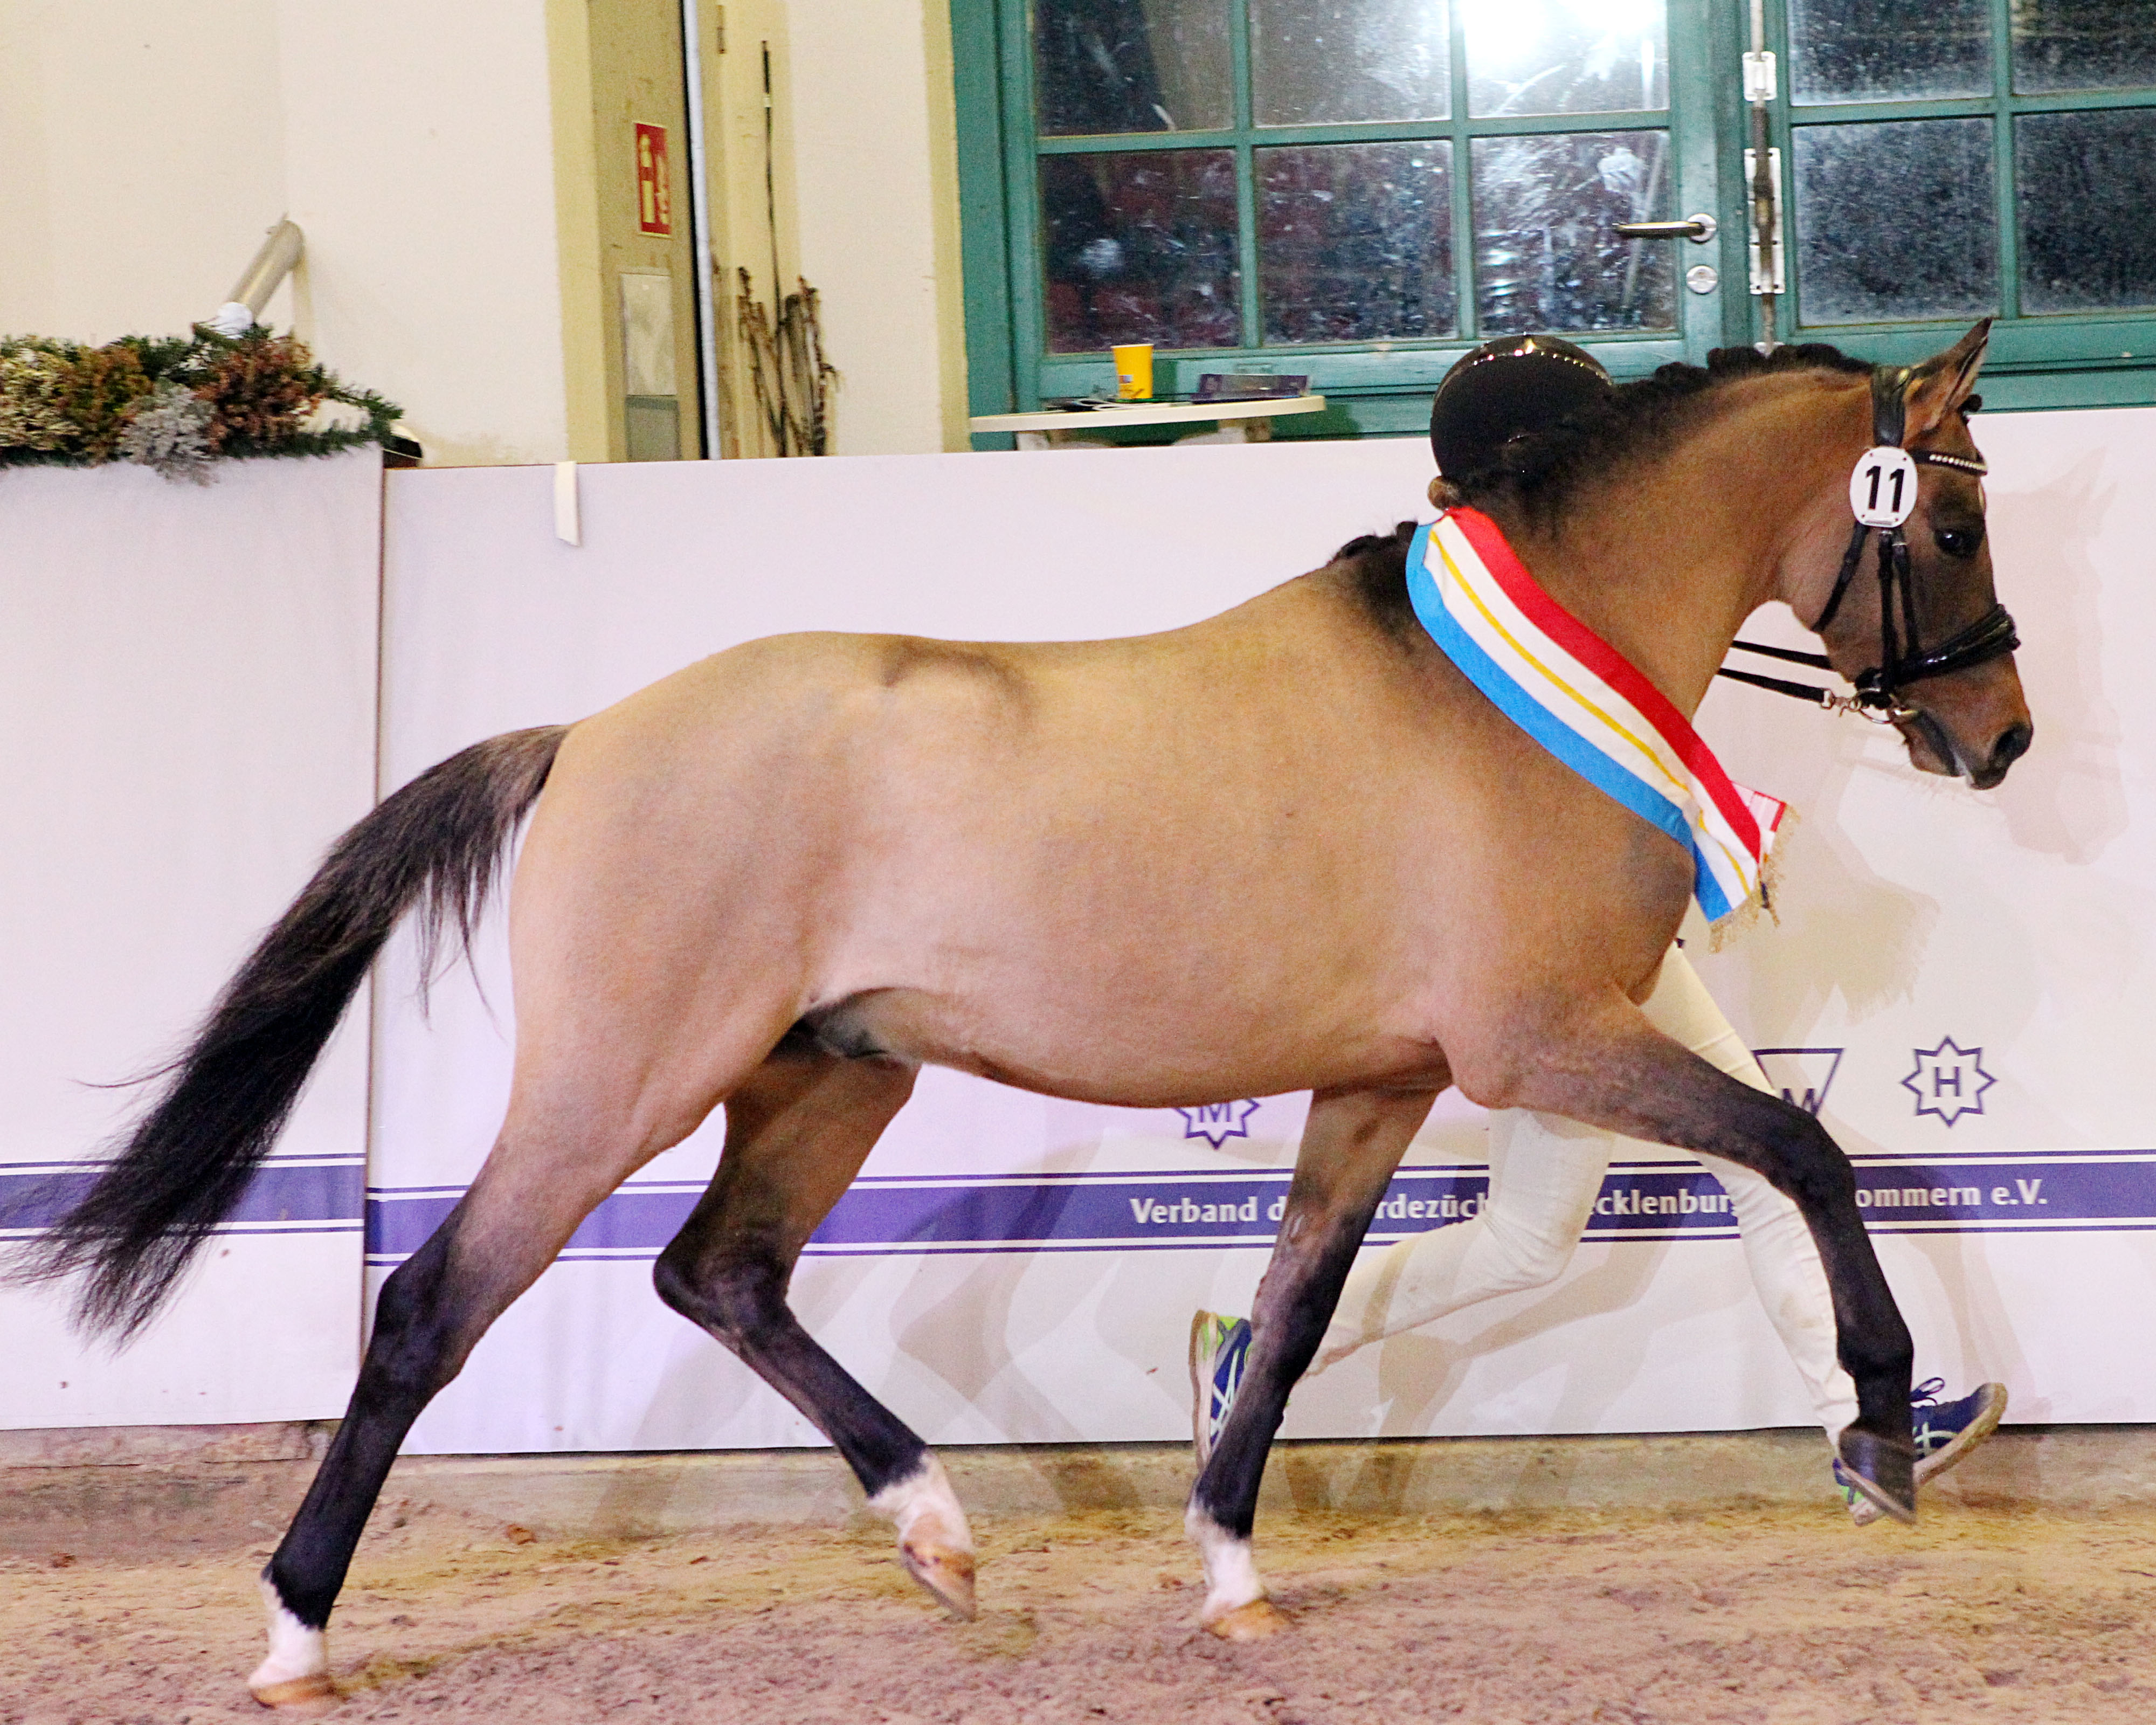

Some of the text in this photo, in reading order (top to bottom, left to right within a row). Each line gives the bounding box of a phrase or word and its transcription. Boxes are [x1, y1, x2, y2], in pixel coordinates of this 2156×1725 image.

[1865, 465, 1905, 513] 11
[1934, 1066, 1960, 1098] H
[1130, 1179, 2048, 1224] Verband d rdezüch cklenbur ommern e.V.
